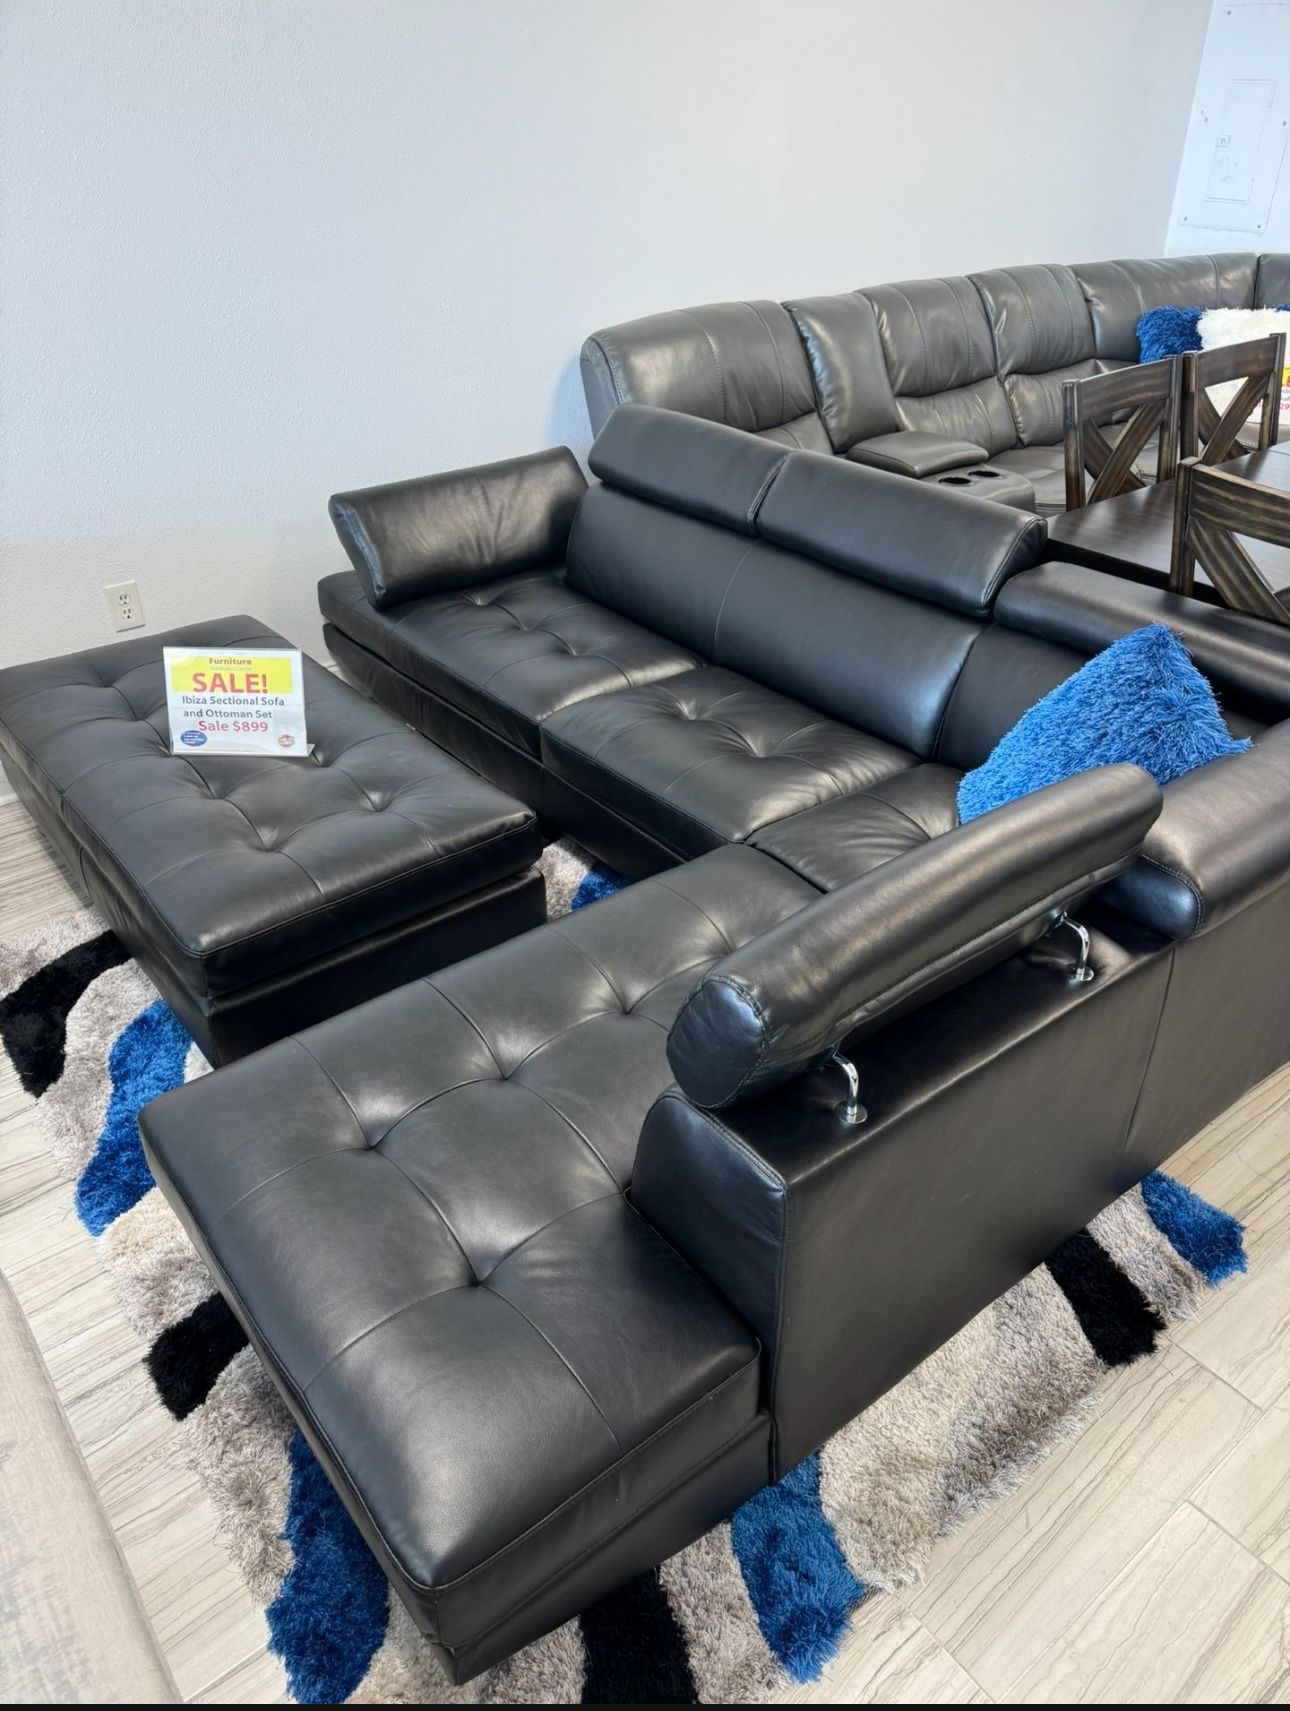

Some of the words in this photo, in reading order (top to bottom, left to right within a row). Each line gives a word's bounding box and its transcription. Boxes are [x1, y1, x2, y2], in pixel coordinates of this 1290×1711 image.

[209, 657, 252, 665] Furniture
[192, 672, 268, 694] SALE!
[182, 696, 207, 705] Ibiza
[209, 696, 259, 706] Sectional
[261, 697, 285, 706] Sofa
[183, 709, 203, 718] and
[206, 709, 253, 718] Ottoman
[255, 710, 272, 719] Set
[198, 720, 229, 732] Sale
[233, 720, 269, 733] $899
